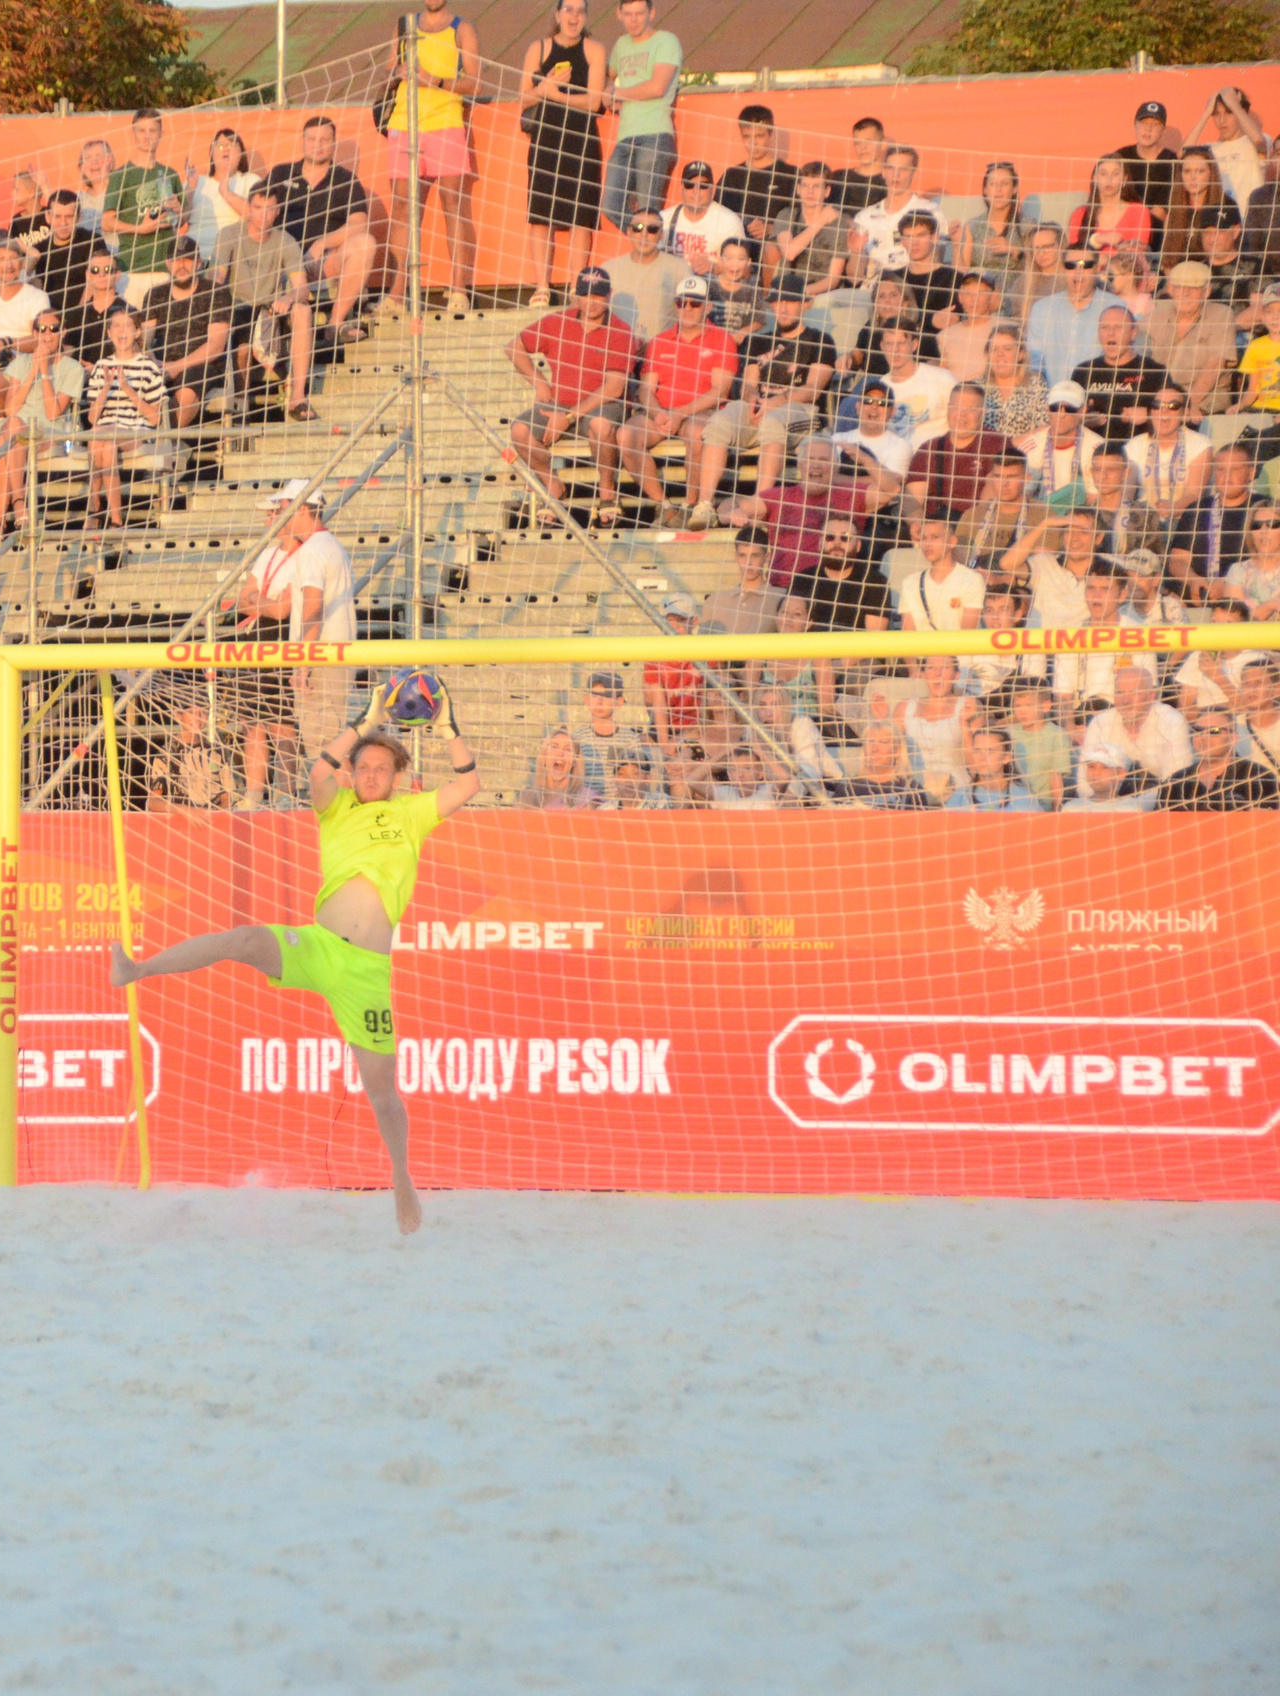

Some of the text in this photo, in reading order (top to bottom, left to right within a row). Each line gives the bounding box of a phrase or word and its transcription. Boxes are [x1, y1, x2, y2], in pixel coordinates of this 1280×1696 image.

[990, 626, 1198, 650] OLIMPBET
[166, 642, 352, 662] OLIMPBET
[369, 829, 403, 841] LEX
[625, 916, 796, 937] ЧЕМПИОНАТ РОССИИ
[1068, 905, 1218, 932] ПЛЯЖНЫЙ
[0, 837, 18, 1034] OLIMPBET
[389, 921, 604, 950] LIMPBET
[363, 1008, 393, 1034] 99
[242, 1037, 671, 1100] ПО ПРООКОДУ PESOK
[900, 1052, 1256, 1097] OLIMPBET
